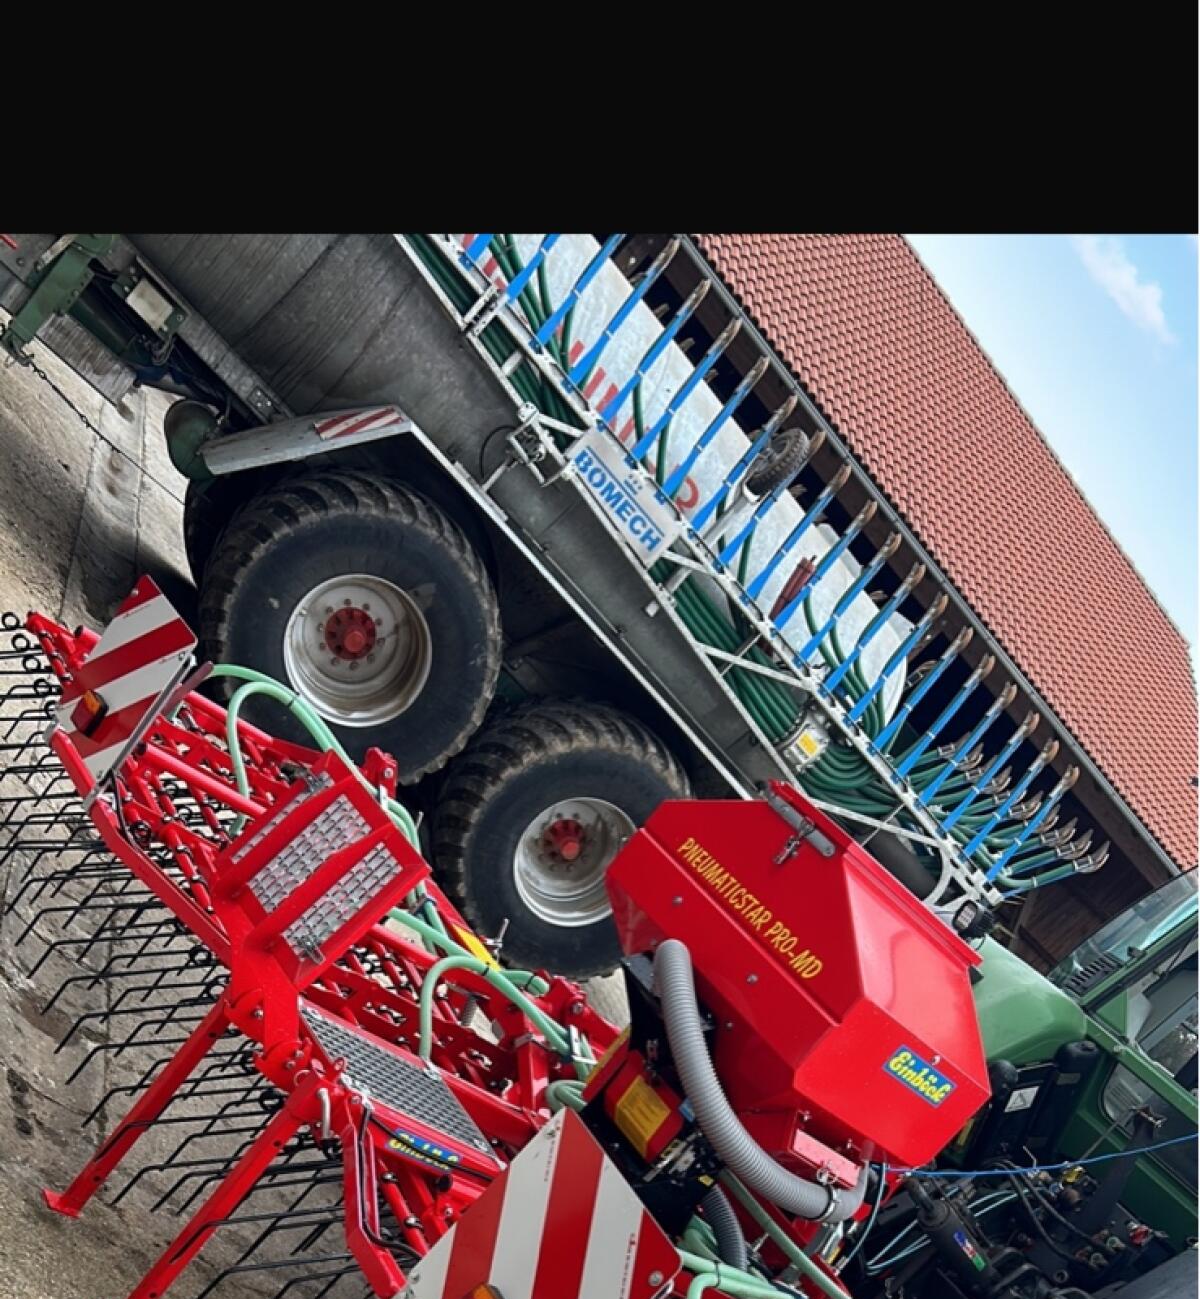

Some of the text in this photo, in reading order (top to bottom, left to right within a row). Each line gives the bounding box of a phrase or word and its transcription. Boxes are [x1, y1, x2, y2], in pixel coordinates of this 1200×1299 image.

[575, 449, 662, 552] BOMECH
[677, 837, 823, 979] PNEUMATICSTAR PRO-MD
